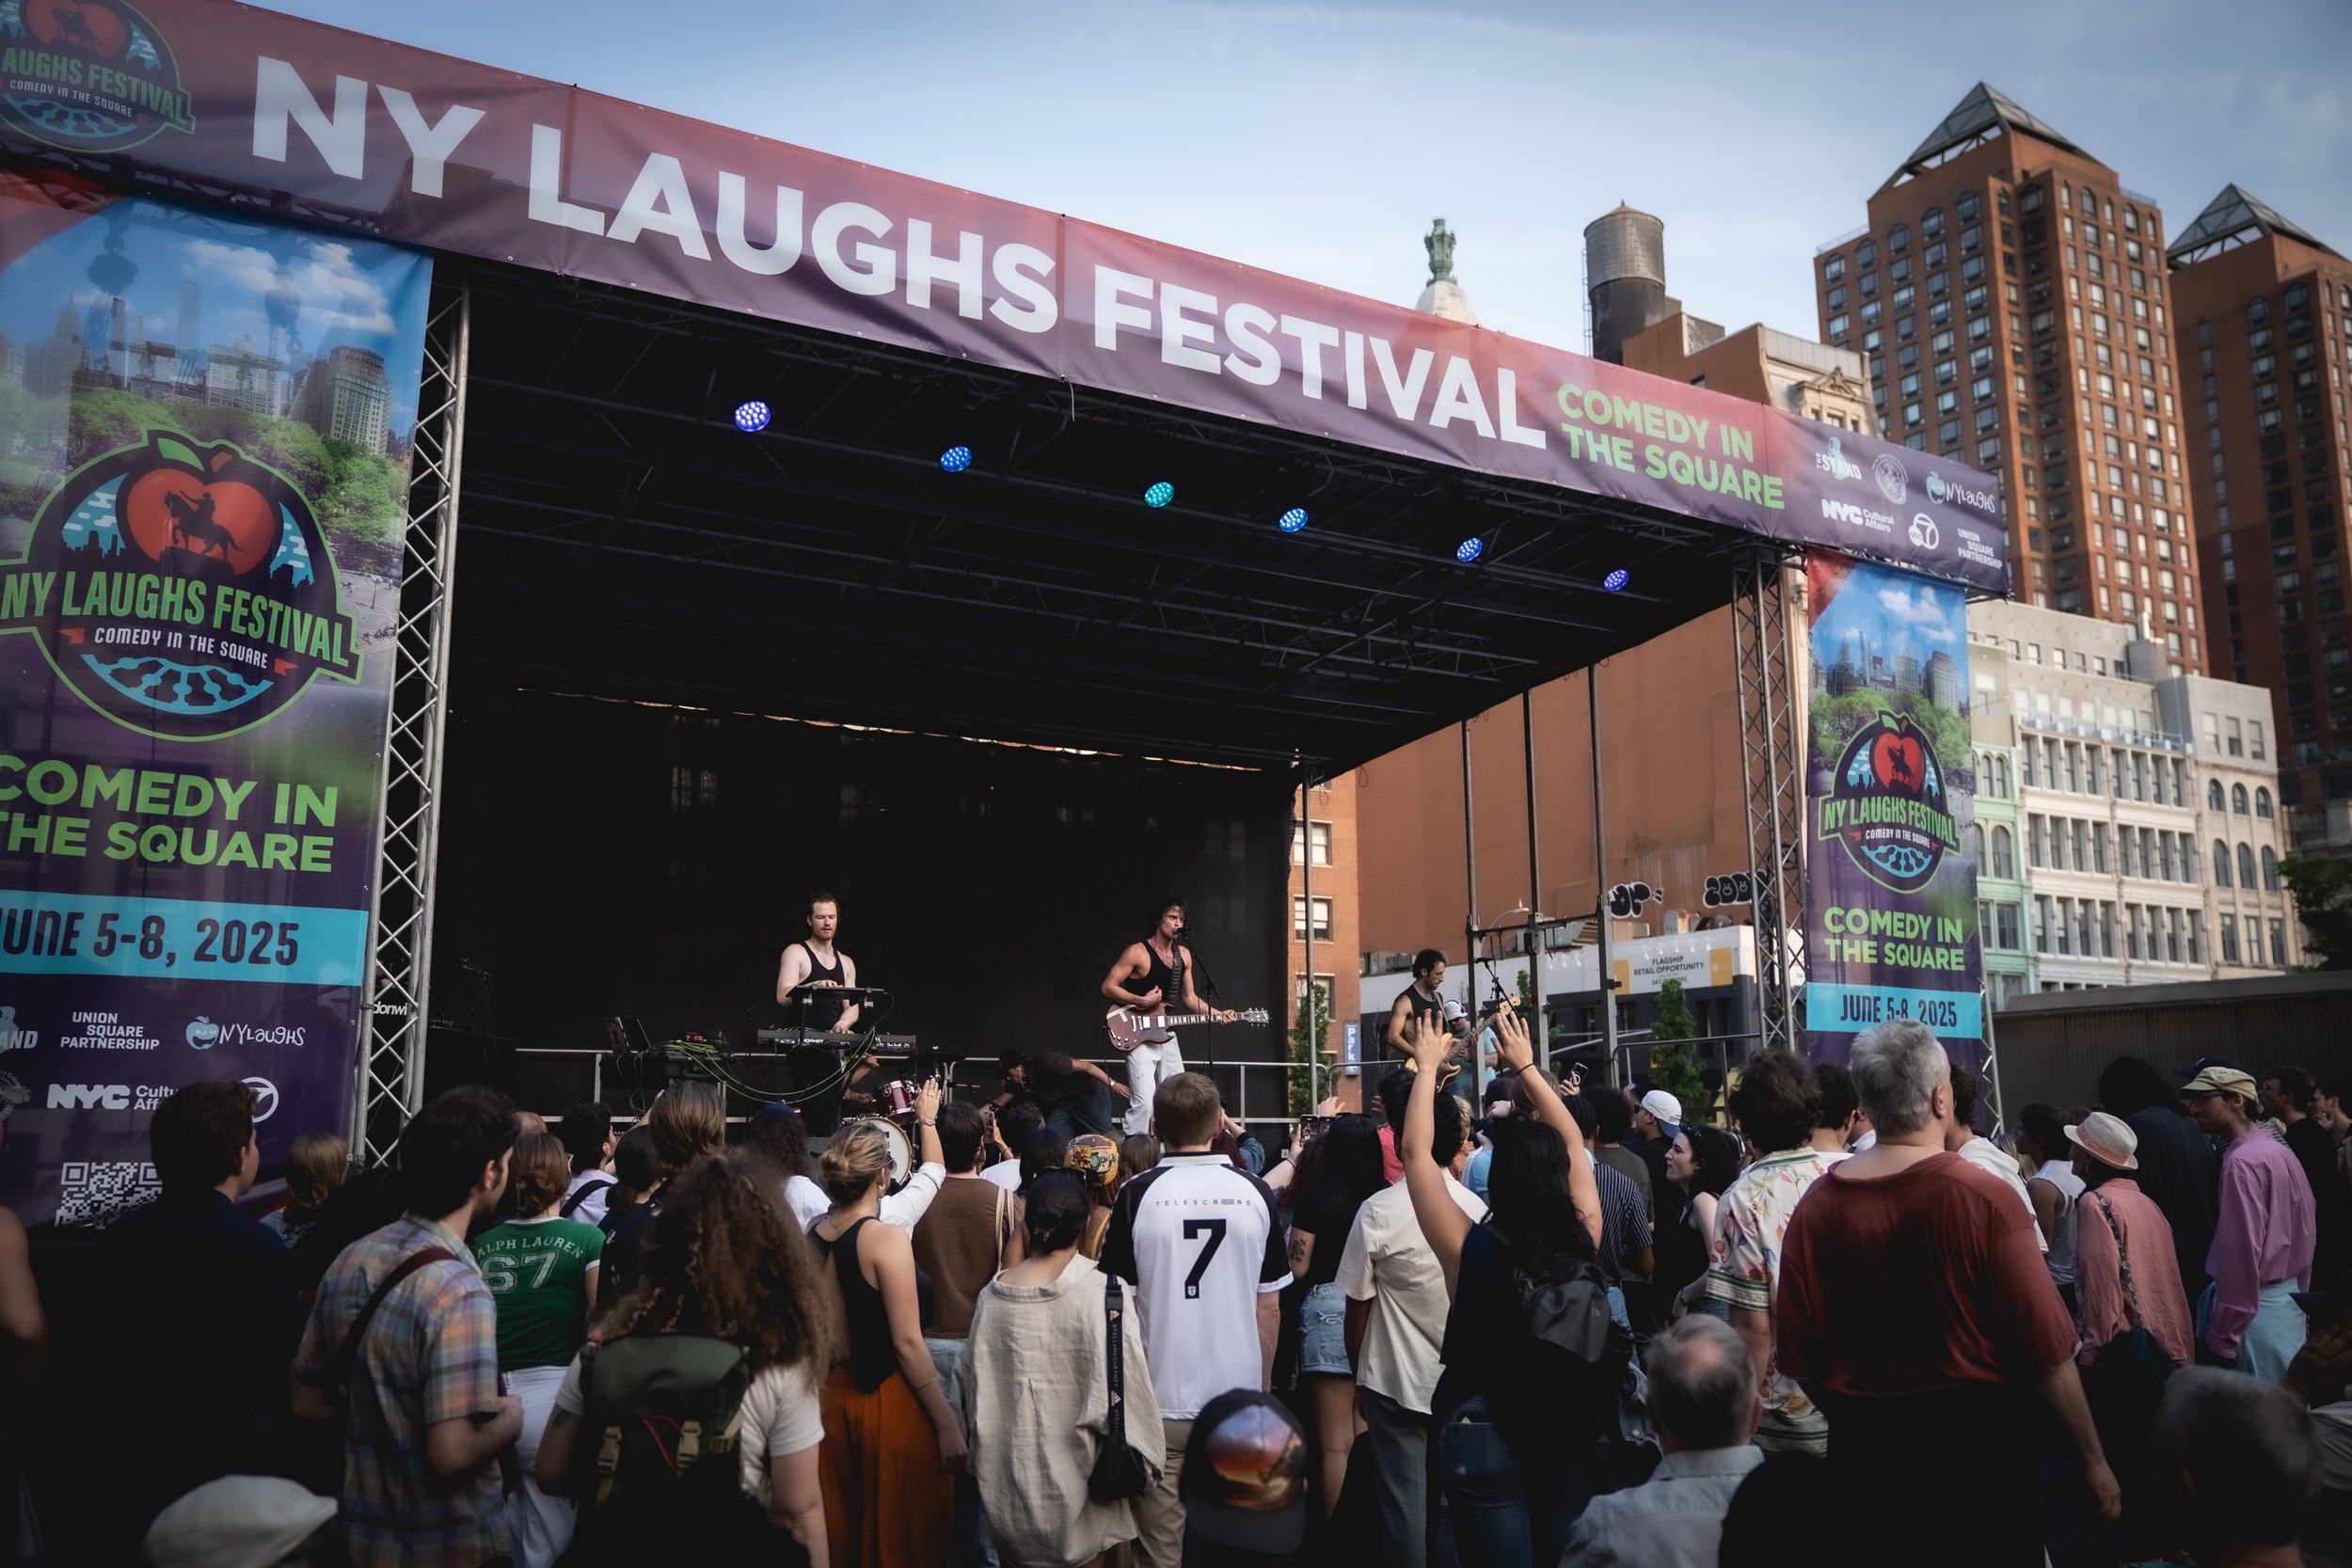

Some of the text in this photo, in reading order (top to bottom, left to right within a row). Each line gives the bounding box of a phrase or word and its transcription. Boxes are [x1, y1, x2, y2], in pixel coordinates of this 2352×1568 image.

[0, 47, 187, 125] AUGHS FESTIVAL
[9, 79, 133, 118] COMEDY IN THE SQUARE
[252, 55, 1547, 450] NY LAUGHS FESTIVAL
[1557, 383, 1755, 463] COMEDY IN
[1561, 422, 1785, 510] THE SQUARE
[1821, 499, 1895, 526] NYC Cultural
[1865, 520, 1891, 532] Affairs
[1957, 528, 1980, 543] UNION
[1967, 540, 1994, 557] SQUARE
[1957, 547, 2003, 570] PARTNERSHIP
[0, 571, 349, 668] NY LAUGHS FESTIVAL
[94, 626, 268, 669] COMEDY IN THE SQUARE
[0, 754, 339, 828] COMEDY IN
[1825, 796, 1957, 847] NY LAUGHS FESTIVAL
[103, 821, 334, 873] SQUARE
[1866, 829, 1931, 848] COMEDY IN THE SQUARE
[0, 908, 300, 968] UNE 5-8, 2025
[1824, 907, 1963, 943] COMEDY IN
[1633, 967, 1655, 975] RETAIL
[1656, 961, 1705, 974] OPPORTUNITY
[1652, 956, 1684, 965] FLAGSHIP
[1824, 938, 1965, 971] THE SQUARE
[72, 1011, 118, 1024] UNION
[1840, 994, 1881, 1023] JUNE
[1918, 999, 1958, 1027] 2025
[0, 1030, 39, 1050] AND
[60, 1037, 160, 1051] PARTNERSHIP
[87, 1024, 144, 1037] SQUARE
[1347, 1027, 1357, 1061] Park
[47, 1084, 131, 1110] NYC
[135, 1085, 179, 1098] Cultu
[476, 1236, 583, 1259] ALPH LAUREN
[1183, 1218, 1227, 1300] 7
[480, 1248, 561, 1294] 67
